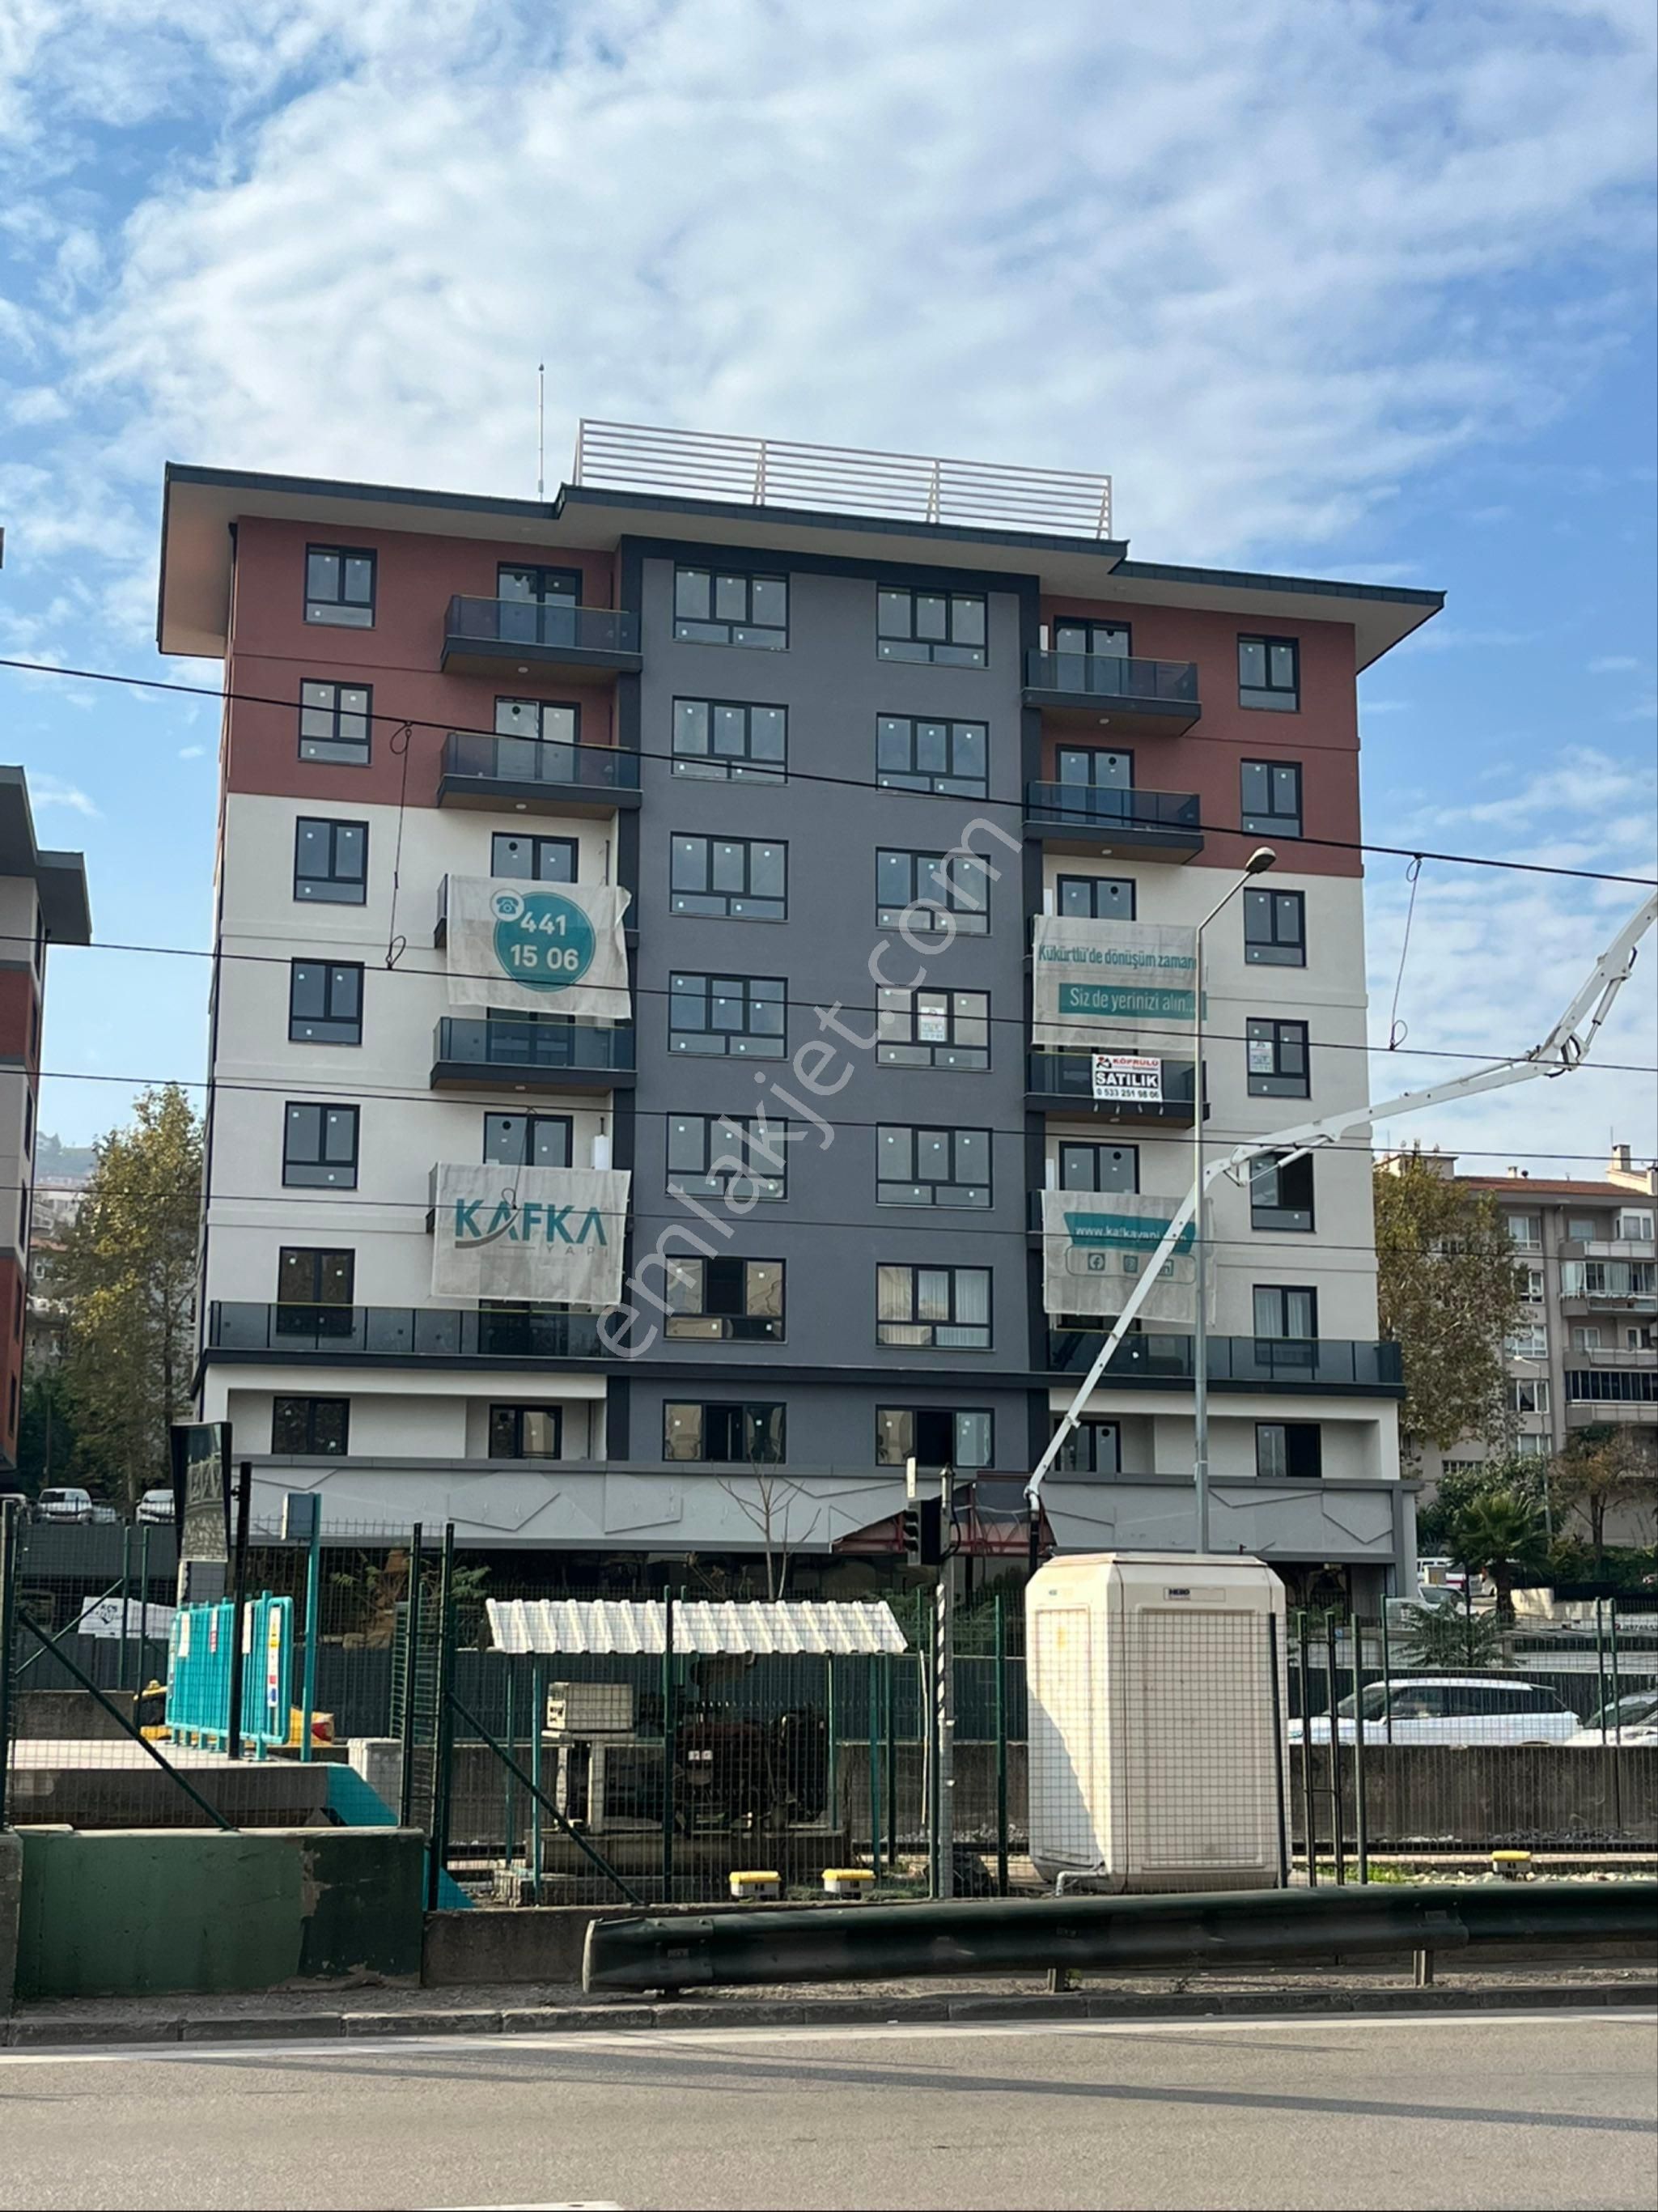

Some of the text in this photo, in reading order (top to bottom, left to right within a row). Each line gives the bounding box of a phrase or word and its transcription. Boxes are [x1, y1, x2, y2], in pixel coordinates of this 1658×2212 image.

[520, 911, 566, 936] 441
[510, 944, 579, 970] 15 06
[1105, 948, 1156, 970] dönüşüm
[1070, 987, 1090, 1007] Siz
[1092, 989, 1109, 1008] de
[1111, 992, 1159, 1012] yerinizi
[1113, 1057, 1159, 1066] KÖPRÜLÜ
[1096, 1072, 1158, 1087] SATILIK
[1096, 1088, 1102, 1096] 0
[1104, 1088, 1119, 1097] 533
[1121, 1089, 1135, 1098] 251
[455, 1198, 608, 1246] KAFKA
[546, 1244, 608, 1257] YAPI
